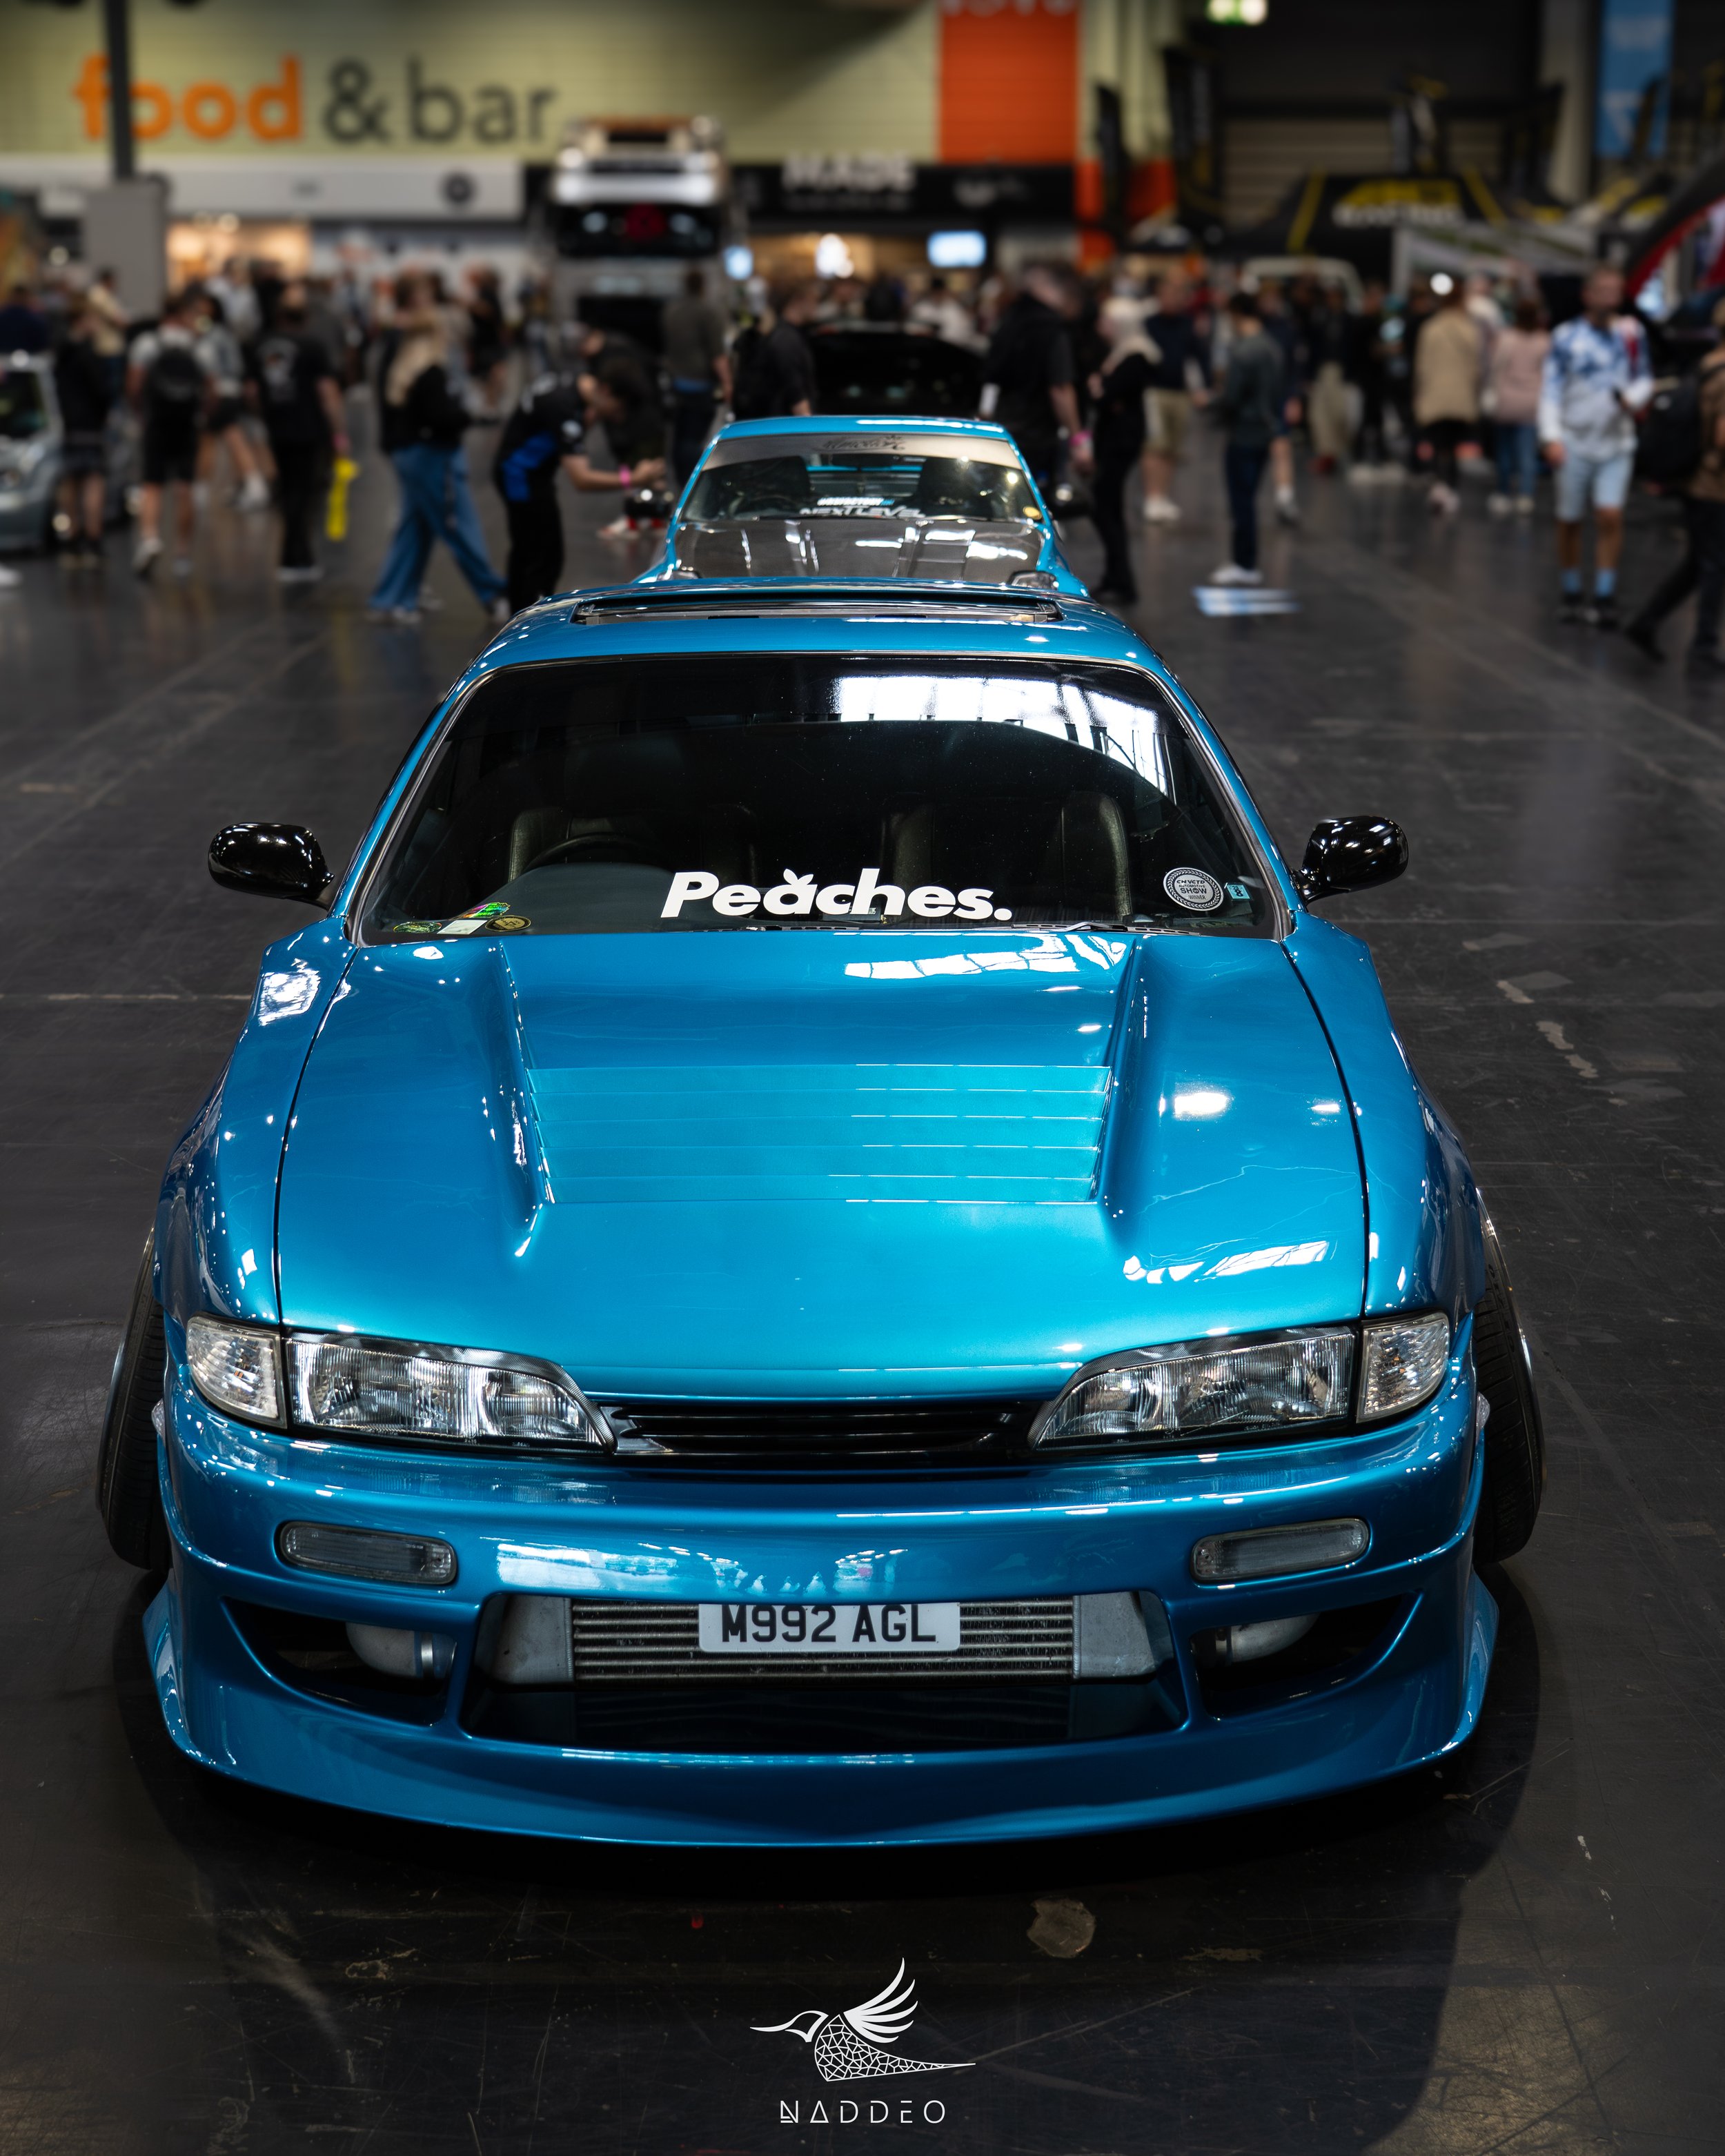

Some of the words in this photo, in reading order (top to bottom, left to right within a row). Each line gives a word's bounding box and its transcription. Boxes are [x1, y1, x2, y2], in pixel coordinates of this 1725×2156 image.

[73, 53, 304, 142] food
[323, 57, 391, 144] &
[410, 55, 557, 144] bar
[660, 868, 1013, 921] Peaches.
[722, 1605, 836, 1643] M992
[852, 1604, 936, 1643] AGL
